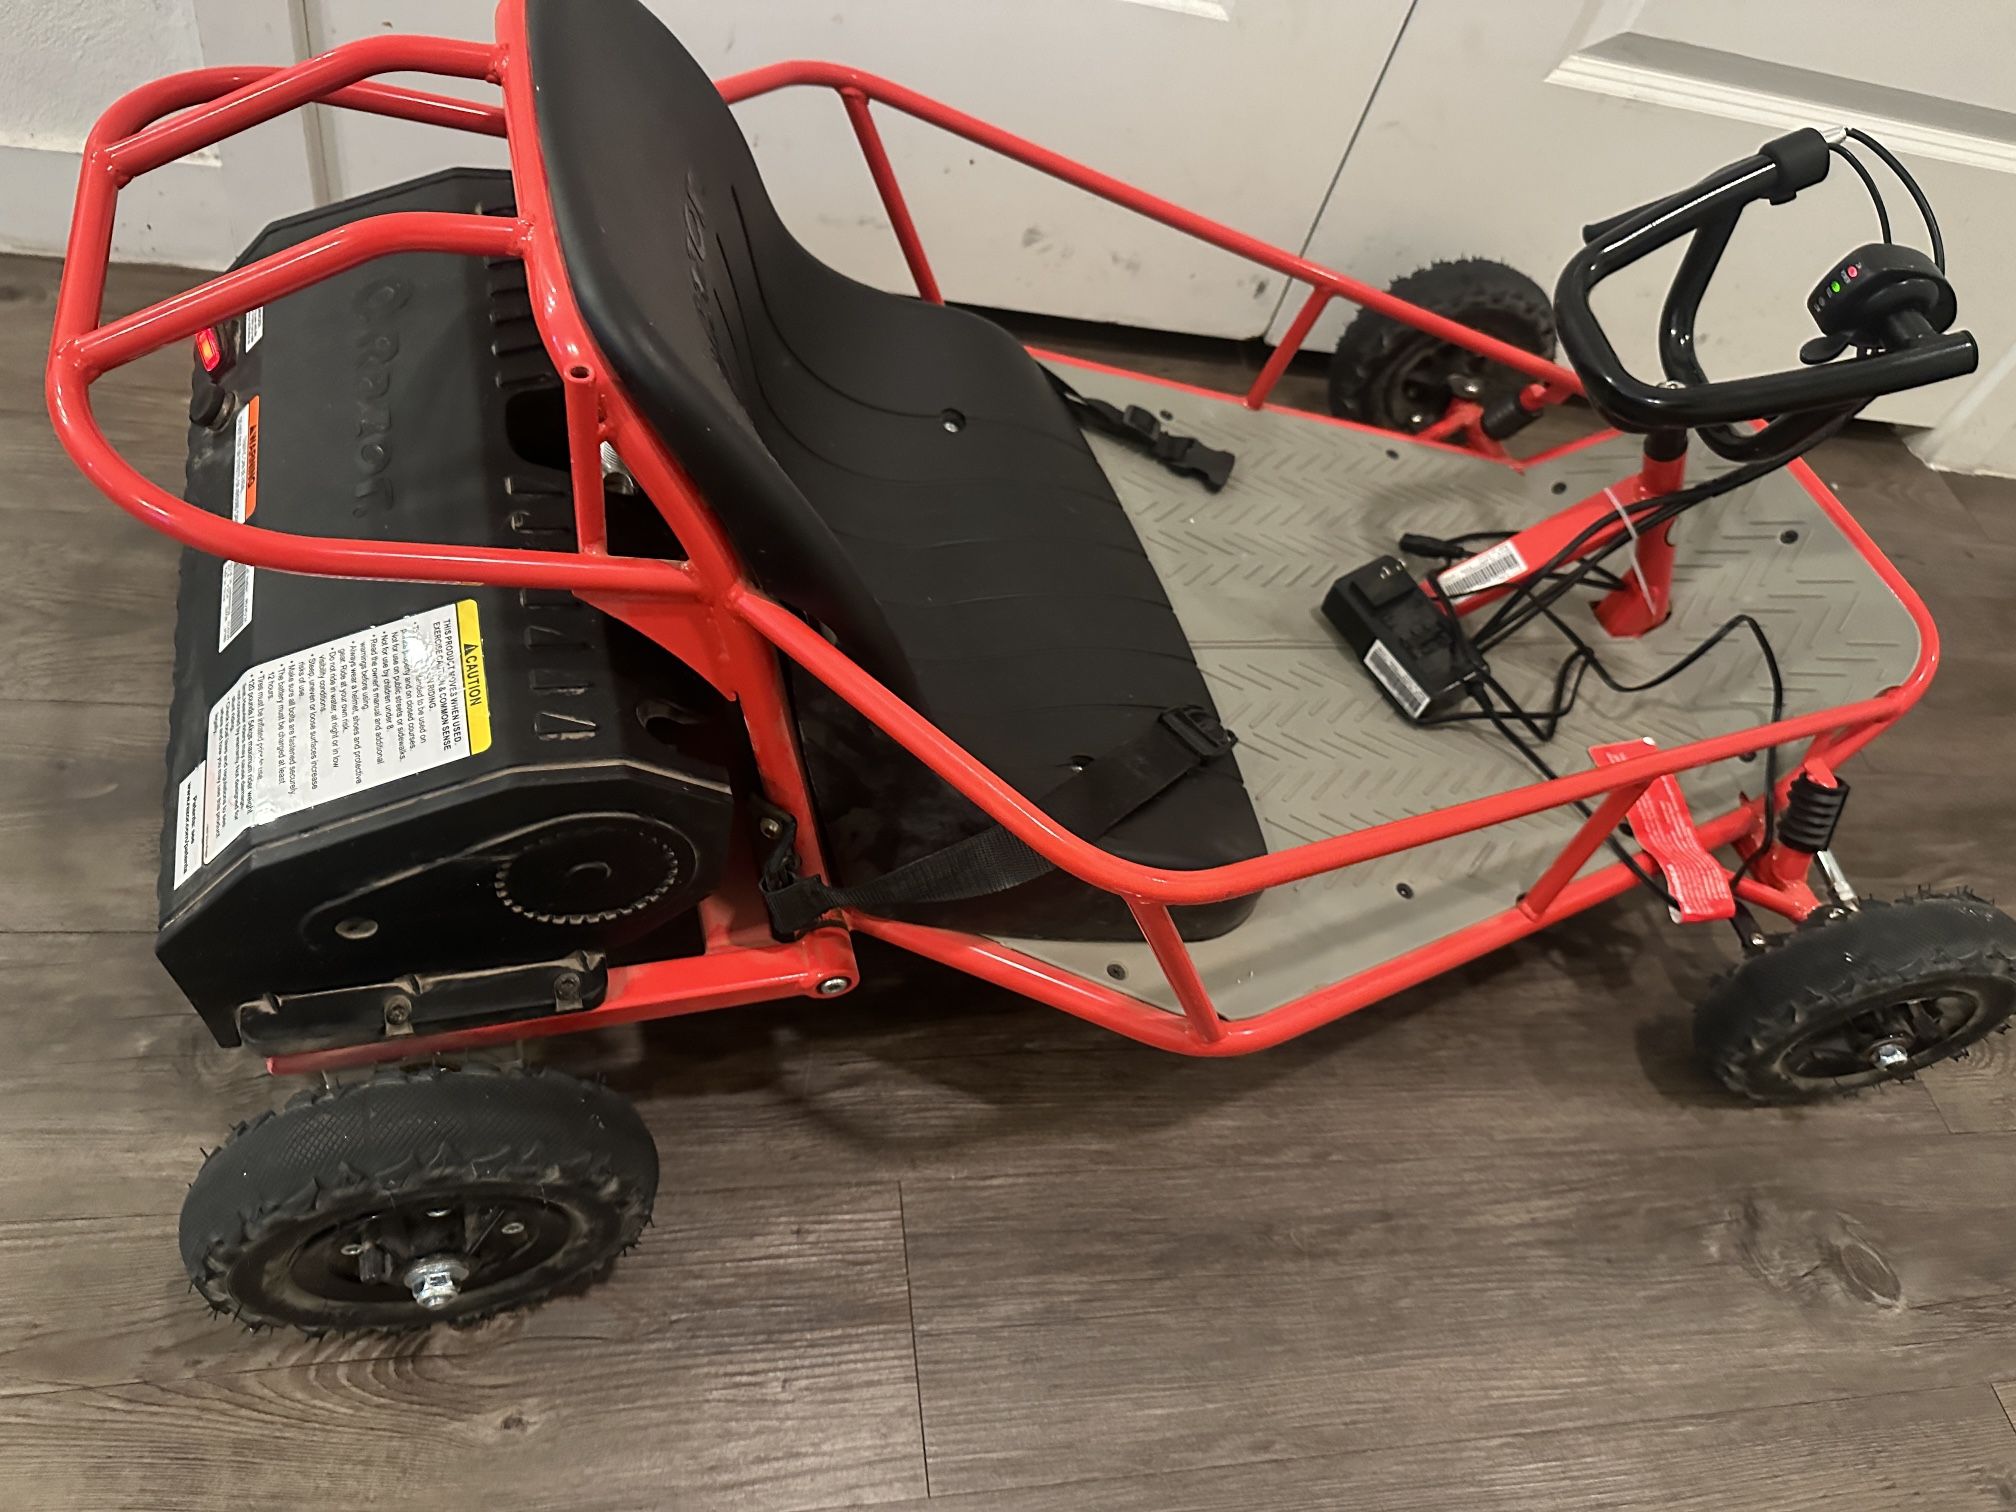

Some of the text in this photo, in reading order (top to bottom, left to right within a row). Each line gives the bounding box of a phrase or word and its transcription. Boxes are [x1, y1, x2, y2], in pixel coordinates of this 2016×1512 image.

[443, 618, 451, 635] THIS
[380, 634, 388, 647] Not
[433, 621, 443, 654] EXERCISE
[328, 651, 335, 661] Do
[347, 644, 357, 668] Always
[358, 641, 367, 670] warnings
[444, 635, 454, 670] PRODUCT
[267, 671, 274, 680] 12
[306, 657, 315, 679] Steep,
[339, 664, 347, 680] Ride
[381, 668, 390, 678] by
[393, 665, 398, 674] on
[298, 676, 305, 684] of
[317, 654, 327, 713] visibility conditions.
[330, 685, 337, 693] in
[340, 680, 347, 688] at
[371, 666, 379, 692] owner's
[392, 674, 401, 695] public
[404, 676, 412, 689] and
[465, 654, 481, 707] CAUTION
[276, 680, 285, 704] battery
[338, 688, 346, 703] your
[383, 677, 391, 703] children
[405, 689, 411, 699] on
[426, 683, 436, 711] RIDING.
[309, 703, 314, 711] or
[328, 693, 337, 714] water,
[349, 689, 359, 715] helmet,
[360, 690, 369, 711] using.
[373, 692, 381, 717] manual
[395, 694, 403, 717] streets
[406, 699, 414, 721] closed
[417, 698, 424, 706] to
[417, 706, 425, 715] be
[439, 692, 449, 725] COMMON
[450, 697, 459, 720] WHEN
[248, 712, 254, 721] /
[257, 707, 264, 717] be
[309, 711, 317, 730] loose
[331, 713, 338, 721] at
[385, 703, 393, 723] under
[396, 718, 402, 726] or
[246, 716, 254, 742] 54kgs
[278, 720, 285, 730] be
[329, 721, 338, 739] night
[352, 714, 360, 735] shoes
[386, 723, 393, 731] 8.
[418, 715, 426, 733] used
[452, 720, 461, 745] USED.
[276, 730, 285, 758] charged
[310, 729, 318, 759] surfaces
[332, 739, 337, 747] or
[353, 735, 361, 750] and
[375, 731, 383, 764] additional
[397, 726, 406, 762] sidewalks.
[419, 734, 425, 743] on
[441, 725, 451, 751] SENSE
[332, 747, 339, 755] in
[278, 758, 286, 766] at
[332, 755, 340, 768] low
[352, 749, 362, 785] protective
[287, 765, 296, 797] securely.
[245, 788, 253, 816] weight
